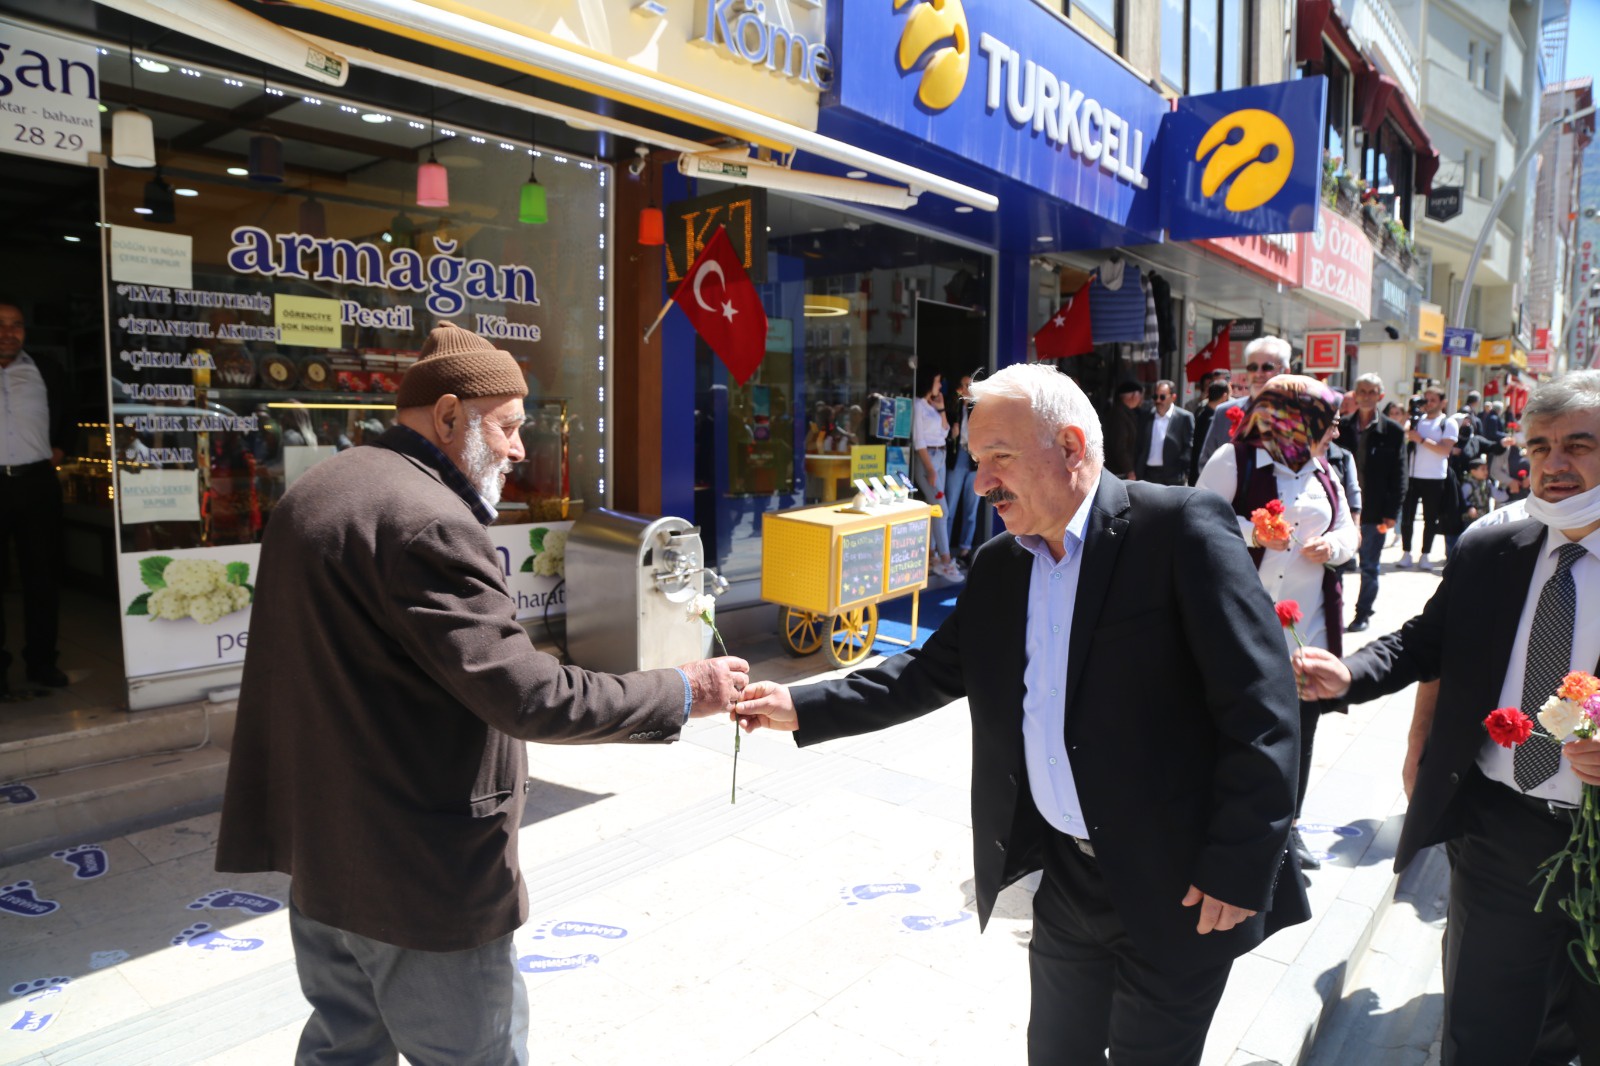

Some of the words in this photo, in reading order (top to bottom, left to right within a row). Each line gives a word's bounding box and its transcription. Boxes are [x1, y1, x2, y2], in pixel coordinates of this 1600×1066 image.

[703, 0, 834, 91] Köme
[42, 107, 94, 128] baharat
[979, 32, 1148, 190] TURKCELL
[14, 123, 45, 146] 28
[54, 131, 83, 152] 29
[227, 226, 540, 316] armağan
[1581, 241, 1592, 283] OTEL
[127, 285, 171, 304] TAZE
[174, 289, 271, 315] KURUYEMİŞ
[127, 314, 214, 339] İSTANBUL
[341, 300, 414, 330] Pestil
[475, 313, 541, 342] Köme
[129, 348, 216, 371] ÇİKOLATA
[1313, 339, 1334, 363] E
[131, 383, 196, 400] LOKUM
[134, 412, 184, 432] TÜRK
[135, 448, 194, 463] AKTAR
[557, 922, 623, 937] BAHARAT
